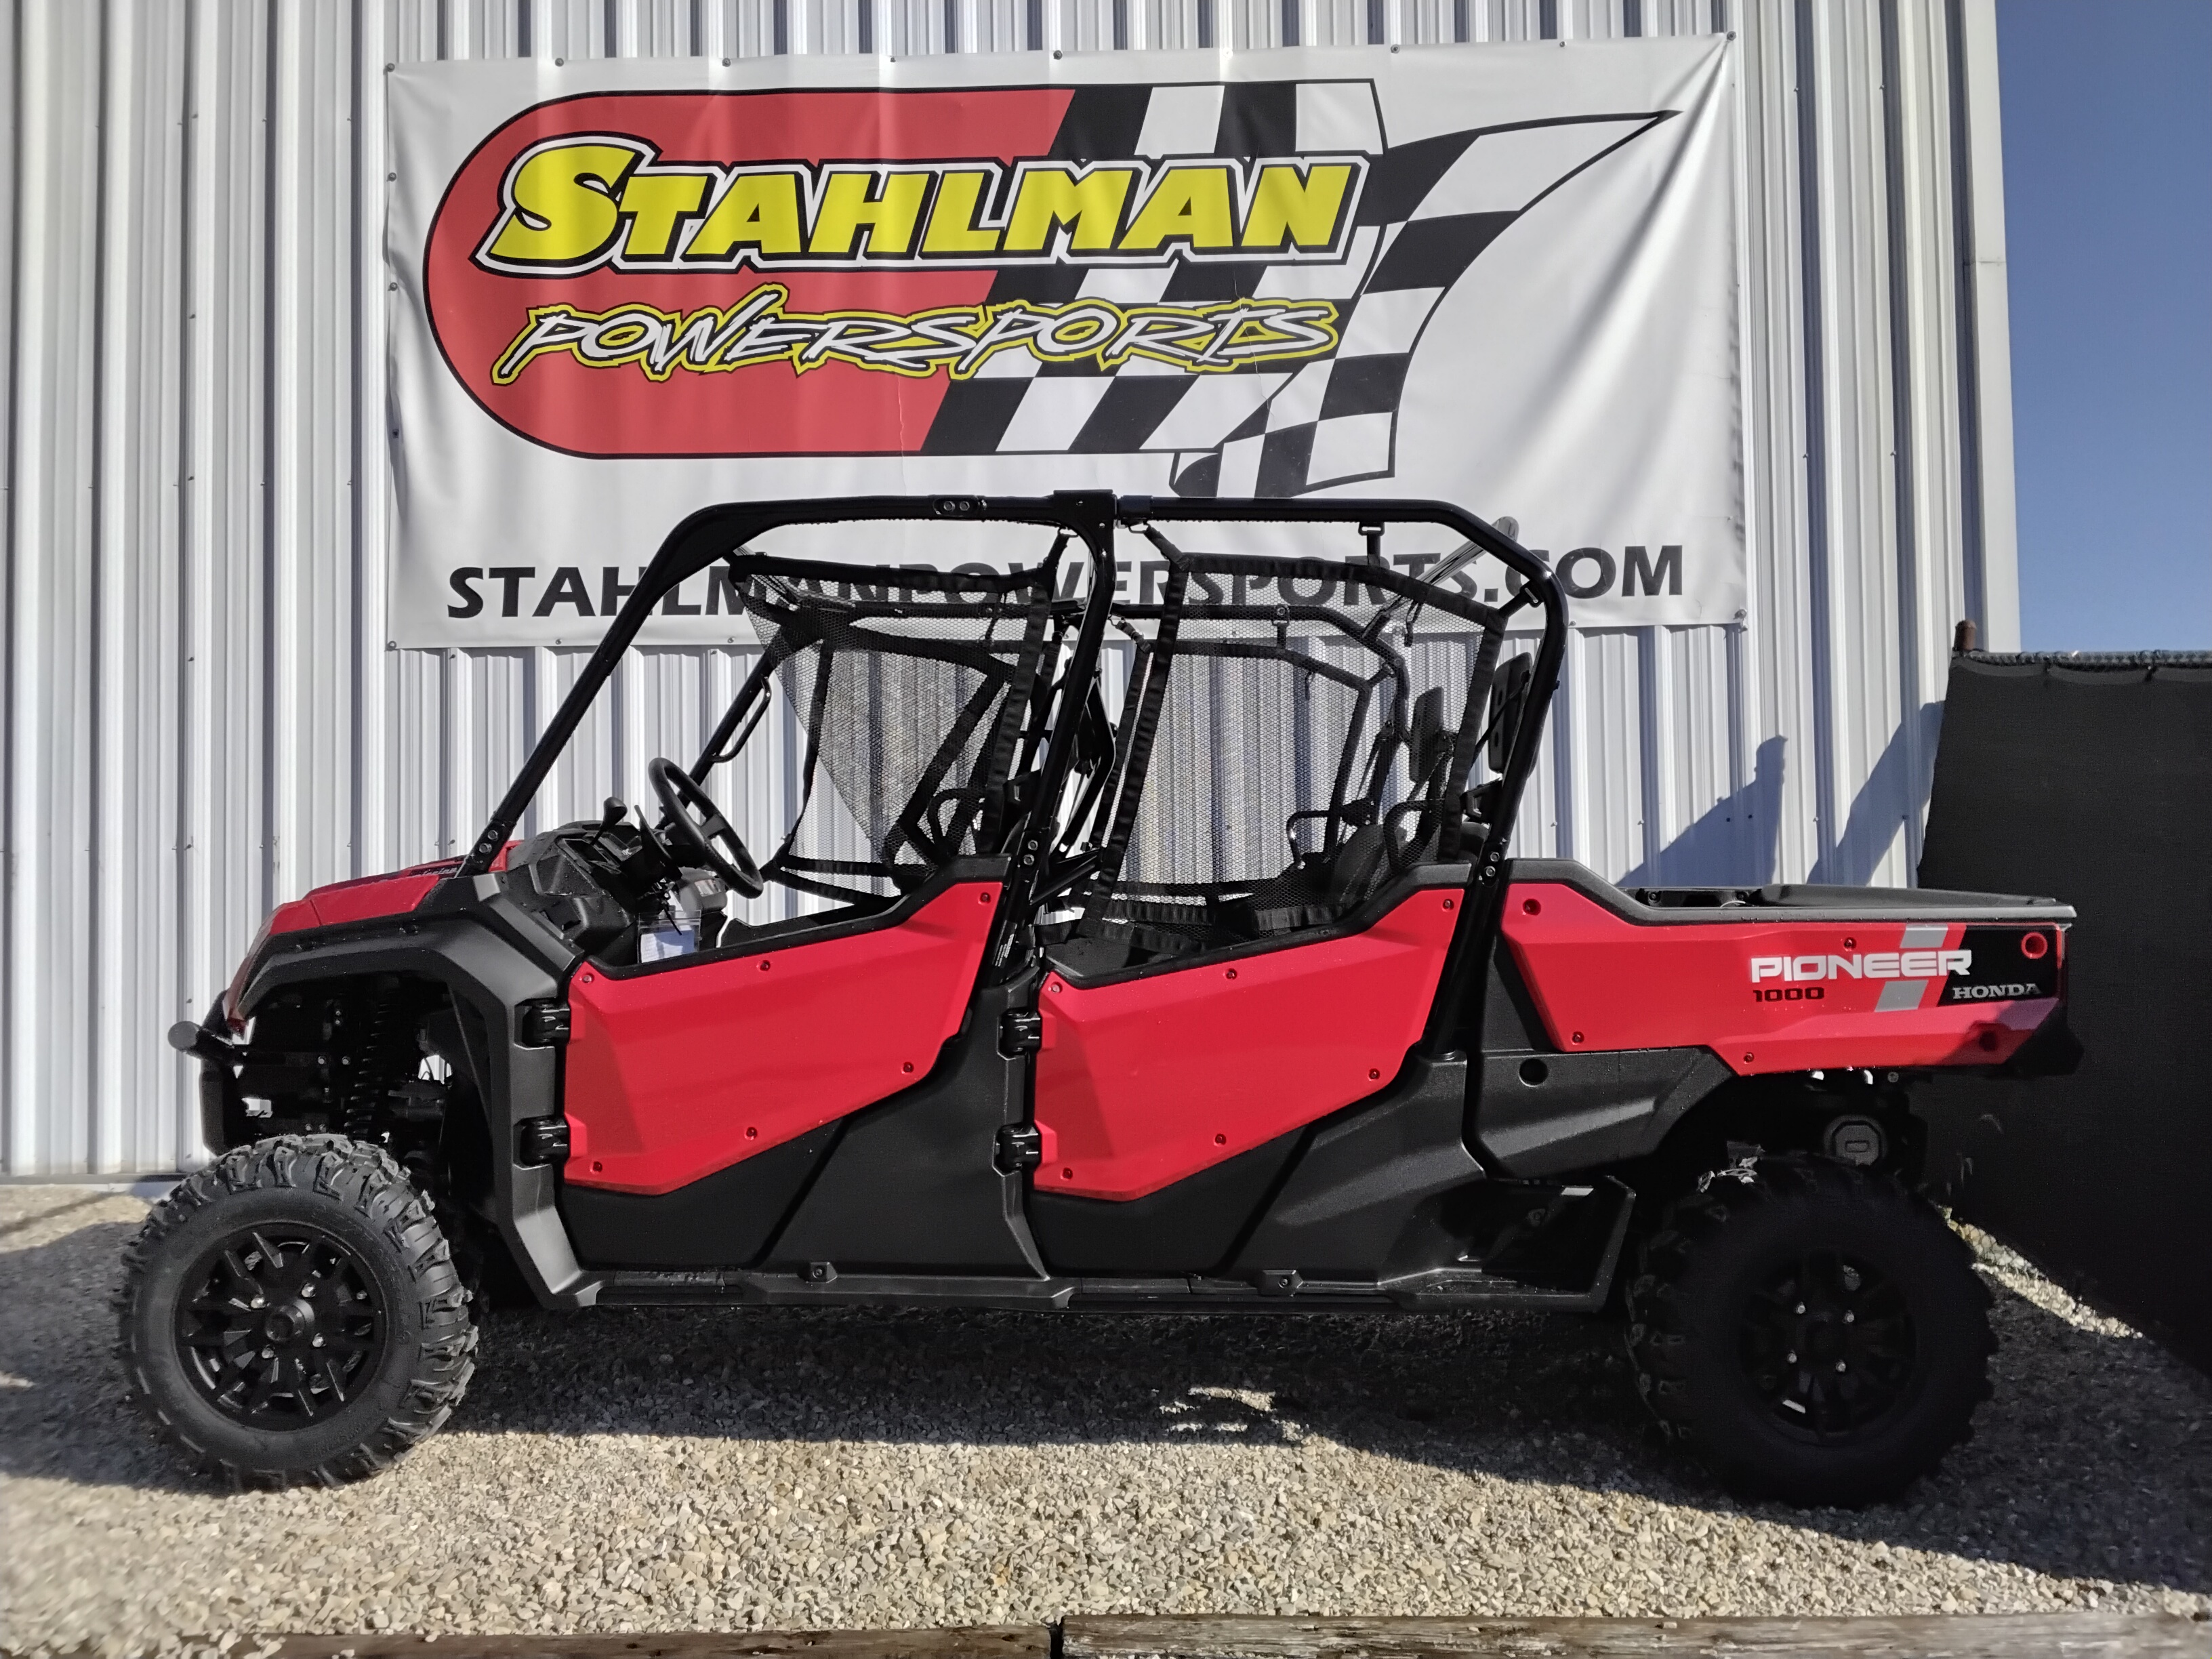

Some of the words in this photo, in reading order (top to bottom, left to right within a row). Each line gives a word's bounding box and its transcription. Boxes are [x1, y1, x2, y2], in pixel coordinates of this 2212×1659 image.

[469, 131, 1370, 279] STAHLMAN
[491, 283, 1339, 385] POWERSPORTS
[1750, 949, 1972, 983] PIONEER
[1753, 987, 1825, 1002] 1000
[1952, 983, 2041, 1000] HONDA
